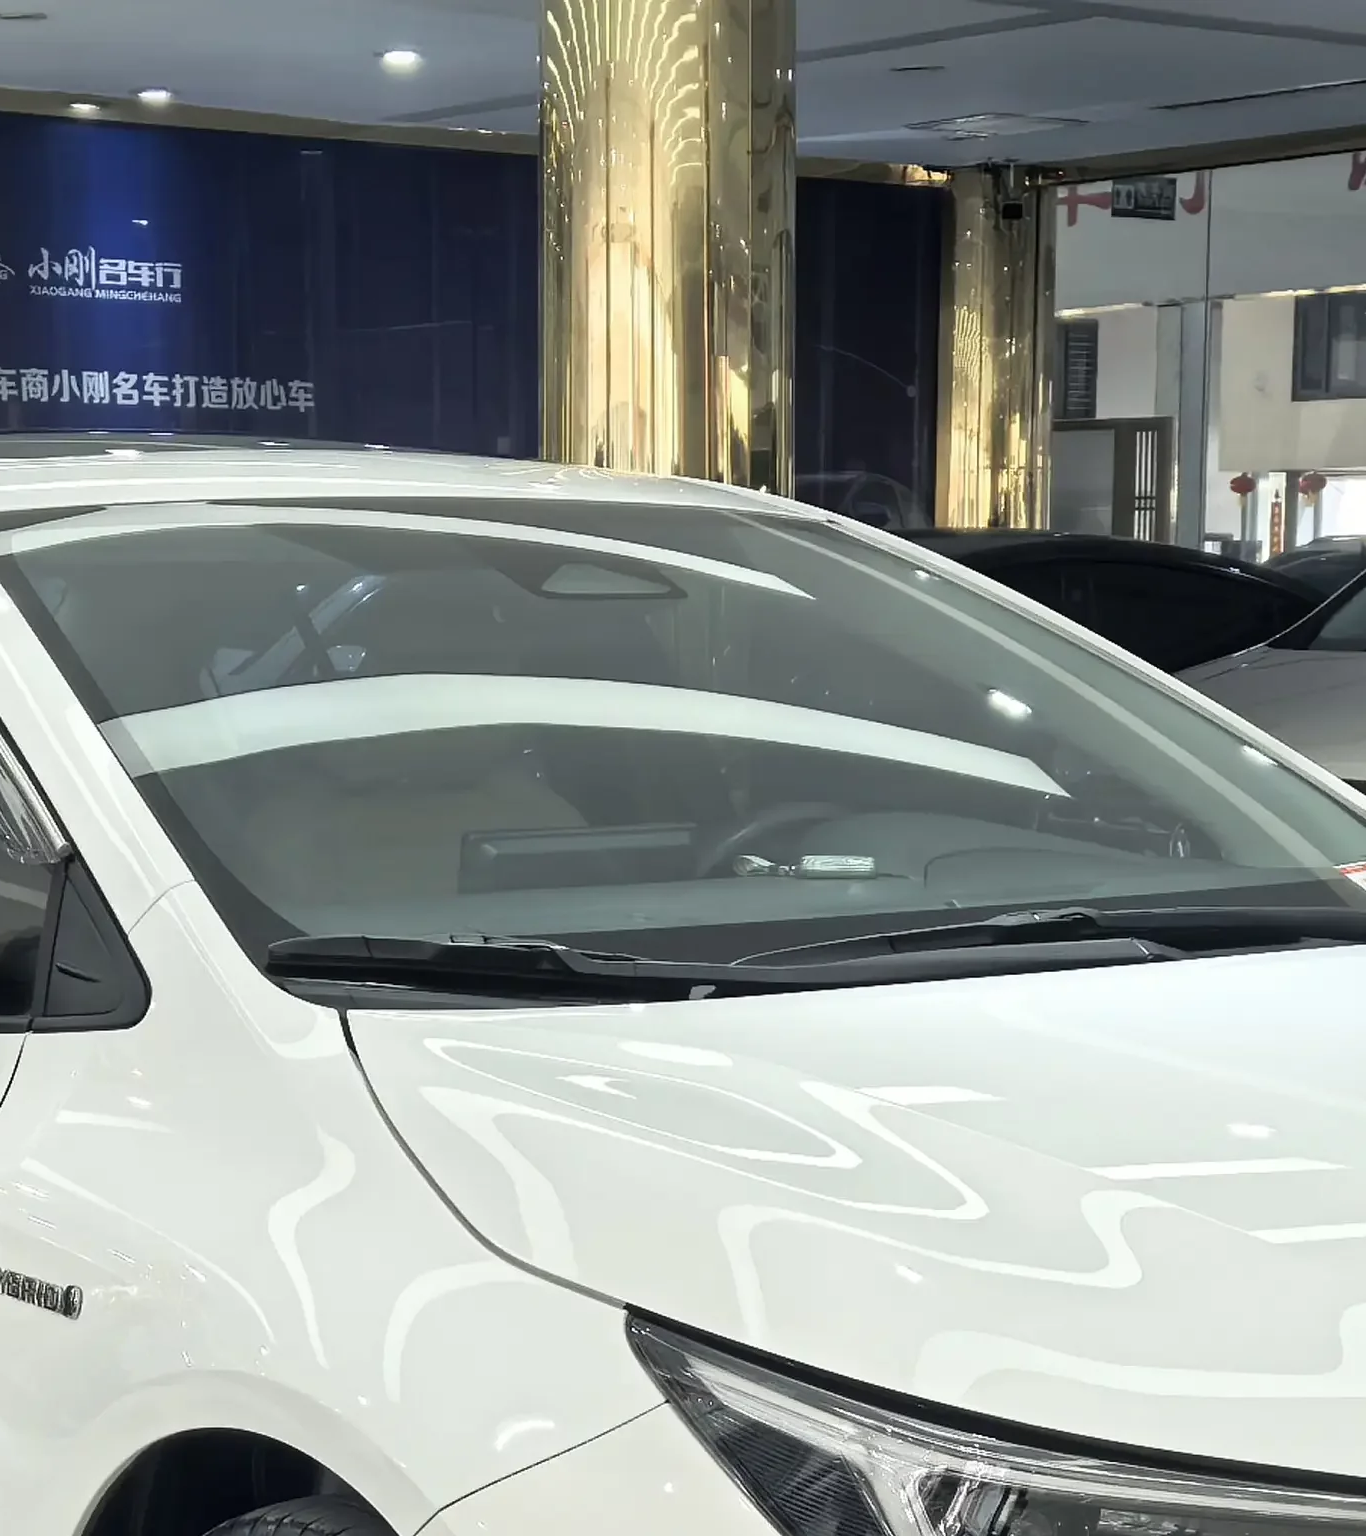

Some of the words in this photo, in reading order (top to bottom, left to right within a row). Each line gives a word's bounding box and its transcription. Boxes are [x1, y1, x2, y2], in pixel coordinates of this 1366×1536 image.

[28, 246, 183, 290] 小刚名车行
[29, 284, 93, 299] XIAOGANG
